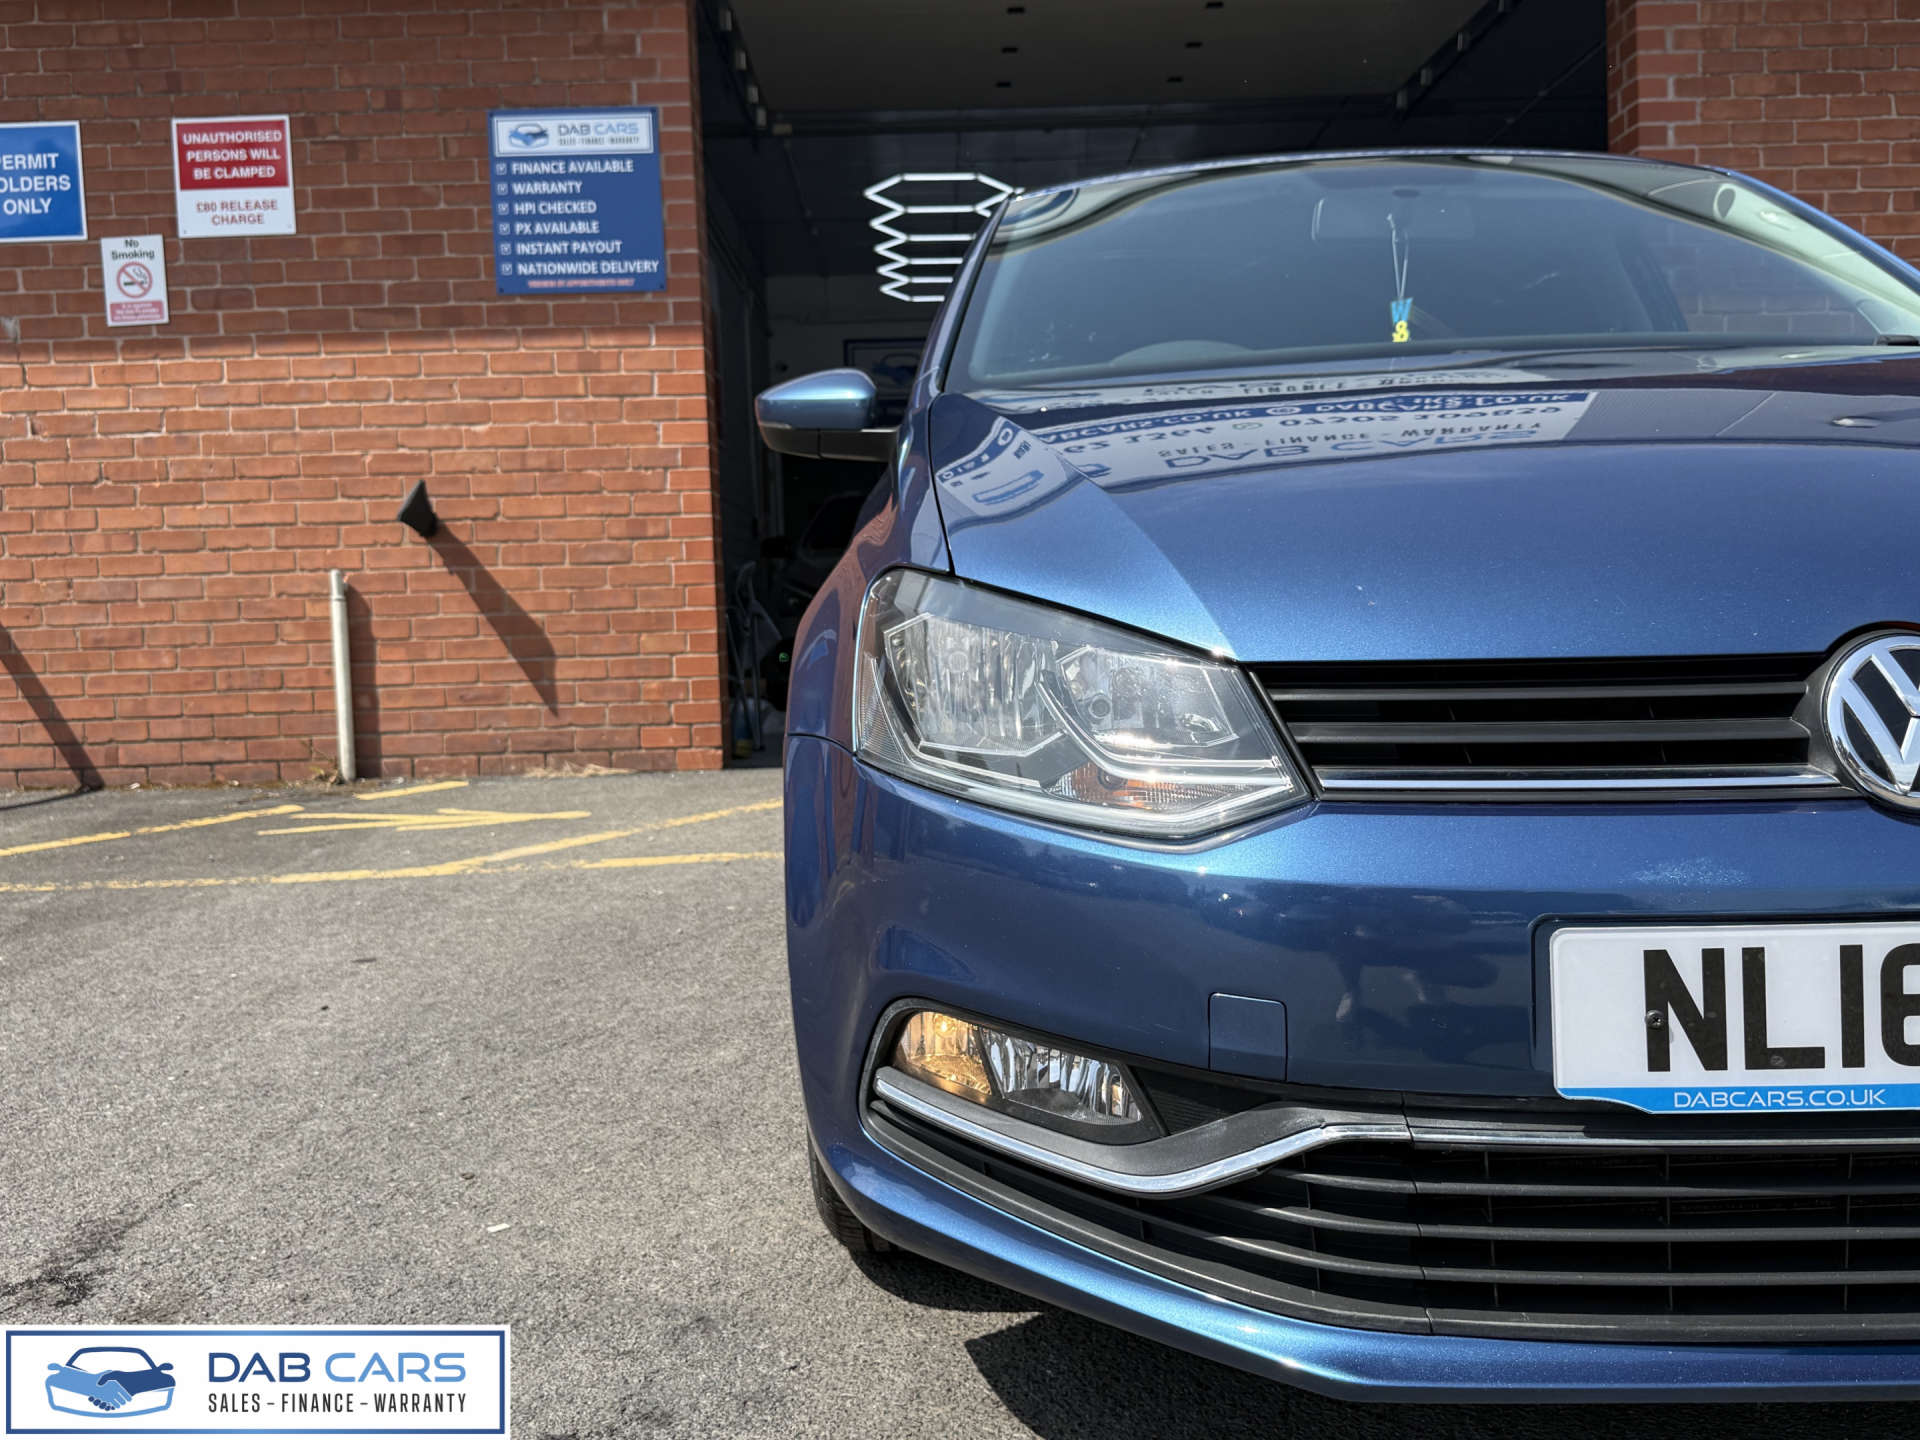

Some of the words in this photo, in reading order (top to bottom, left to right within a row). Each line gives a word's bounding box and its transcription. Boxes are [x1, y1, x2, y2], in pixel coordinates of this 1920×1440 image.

[558, 123, 591, 136] DAB
[594, 122, 639, 135] CARS
[183, 130, 282, 145] UNAUTHORISED
[0, 152, 59, 170] ERMIT
[186, 149, 248, 162] PERSONS
[250, 148, 281, 160] WILL
[193, 167, 211, 180] BE
[214, 165, 276, 179] CLAMPED
[511, 161, 566, 175] FINANCE
[568, 160, 634, 173] AVAILABLE
[512, 181, 583, 195] WARRANTY
[3, 197, 52, 215] ONLY
[221, 200, 278, 211] RELEASE
[514, 202, 537, 215] HPI
[538, 200, 597, 214] CHECKED
[211, 213, 264, 226] CHARGE
[515, 223, 532, 235] PX
[534, 221, 600, 234] AVAILABLE
[124, 238, 139, 248] No
[516, 243, 570, 255] INSTANT
[572, 241, 623, 254] PAYOUT
[111, 249, 155, 261] Smoking
[517, 262, 599, 275] NATIONWIDE
[601, 260, 660, 274] DELIVERY
[1673, 1088, 1887, 1109] DABCARS.CO.UK
